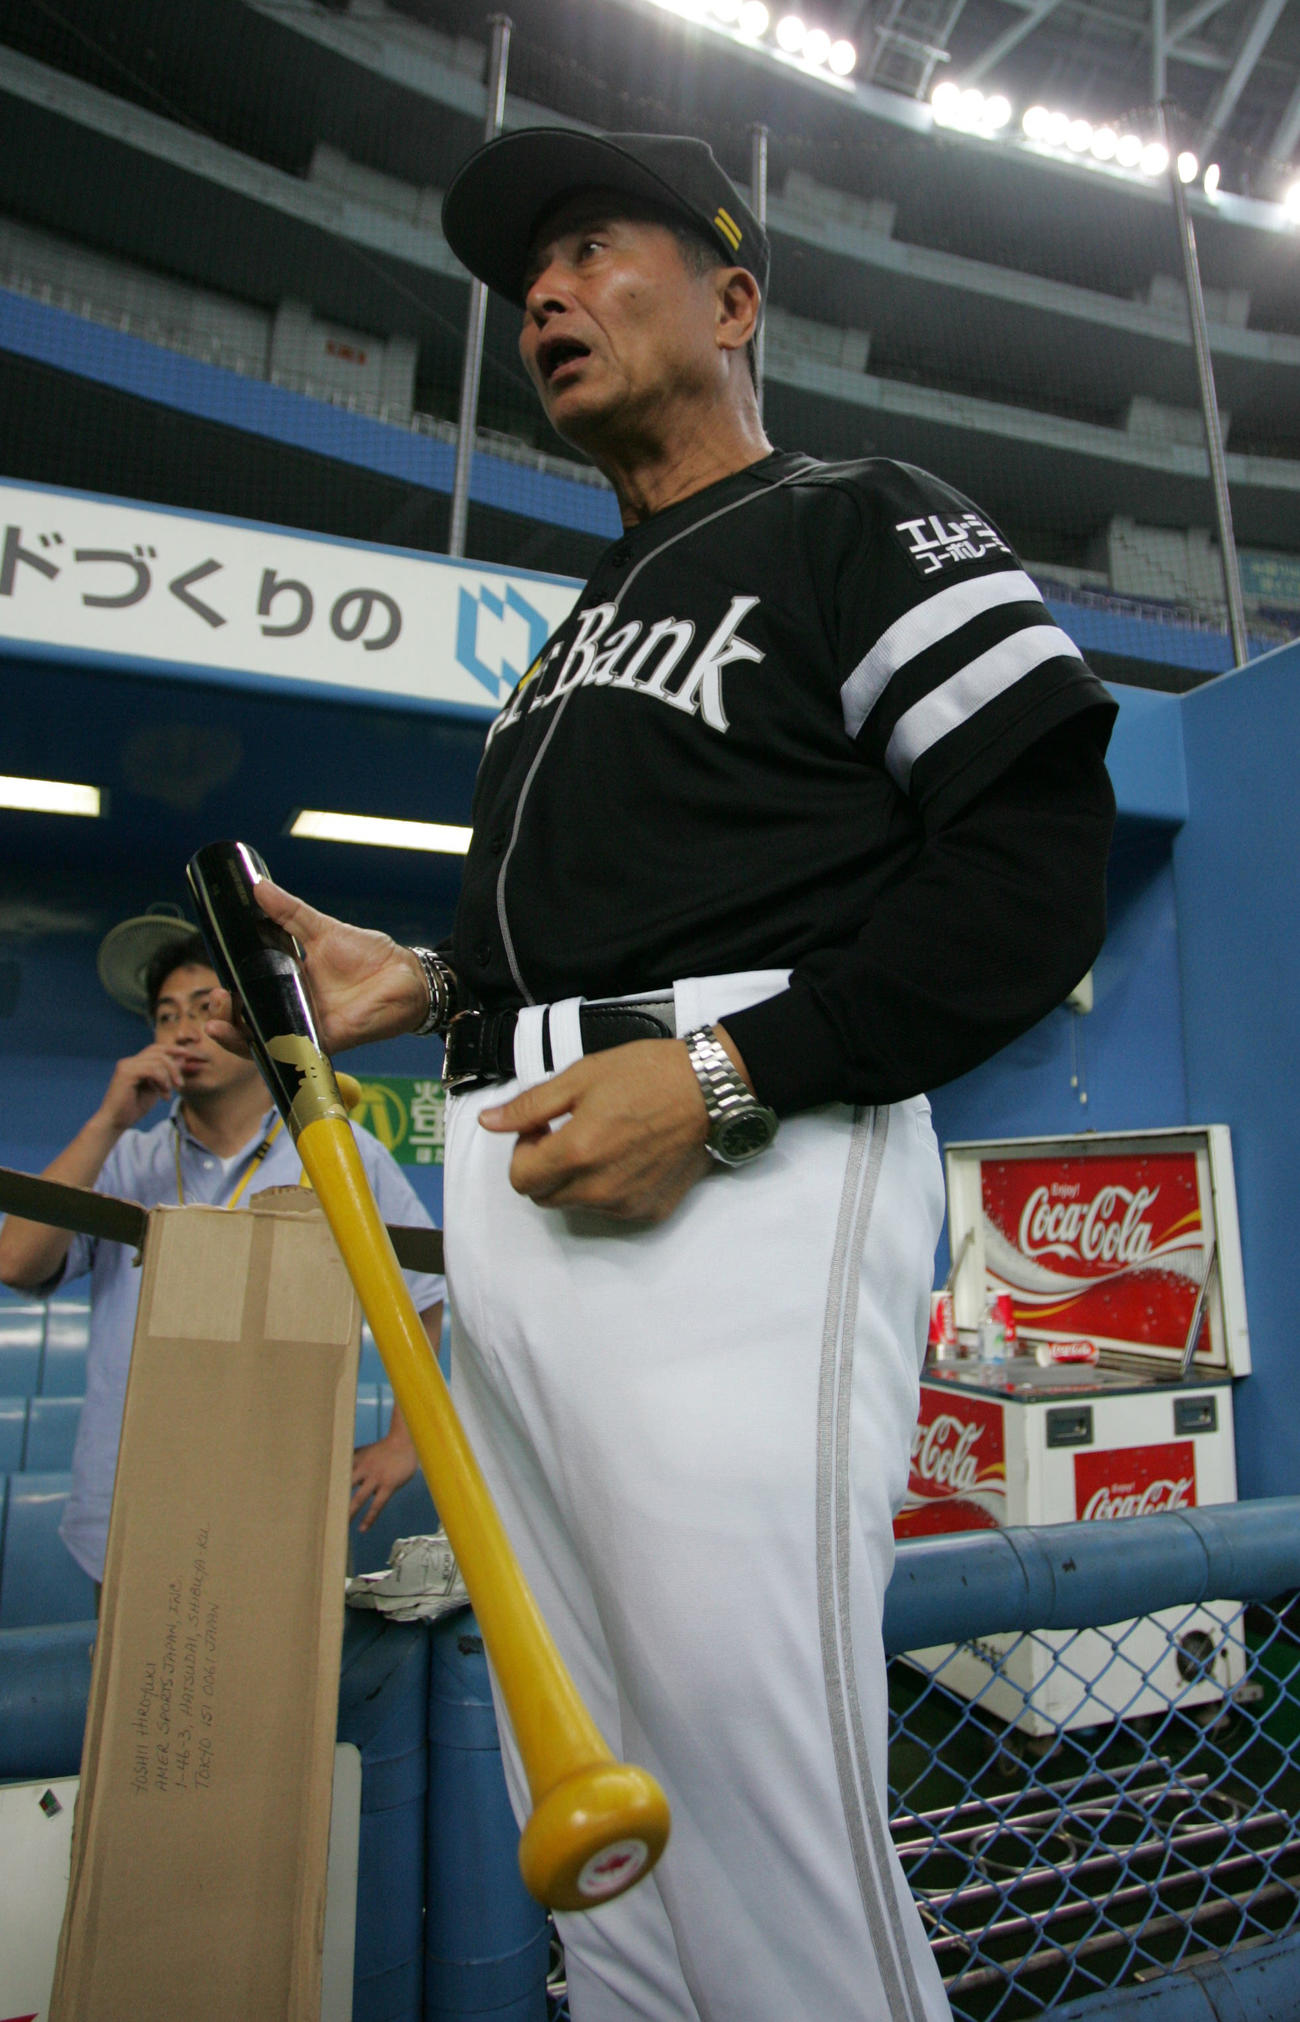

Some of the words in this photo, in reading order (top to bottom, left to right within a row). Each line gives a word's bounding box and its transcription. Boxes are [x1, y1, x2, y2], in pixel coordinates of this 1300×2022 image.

[0, 525, 402, 651] ドづくりの
[1018, 1184, 1160, 1263] Coca-Cola
[204, 1601, 219, 1652] JAPAN
[158, 1678, 173, 1735] SPORTS
[201, 1704, 212, 1727] 151
[133, 1744, 149, 1793] YOSHII
[155, 1742, 169, 1792] AMER
[195, 1738, 214, 1789] TOKYO
